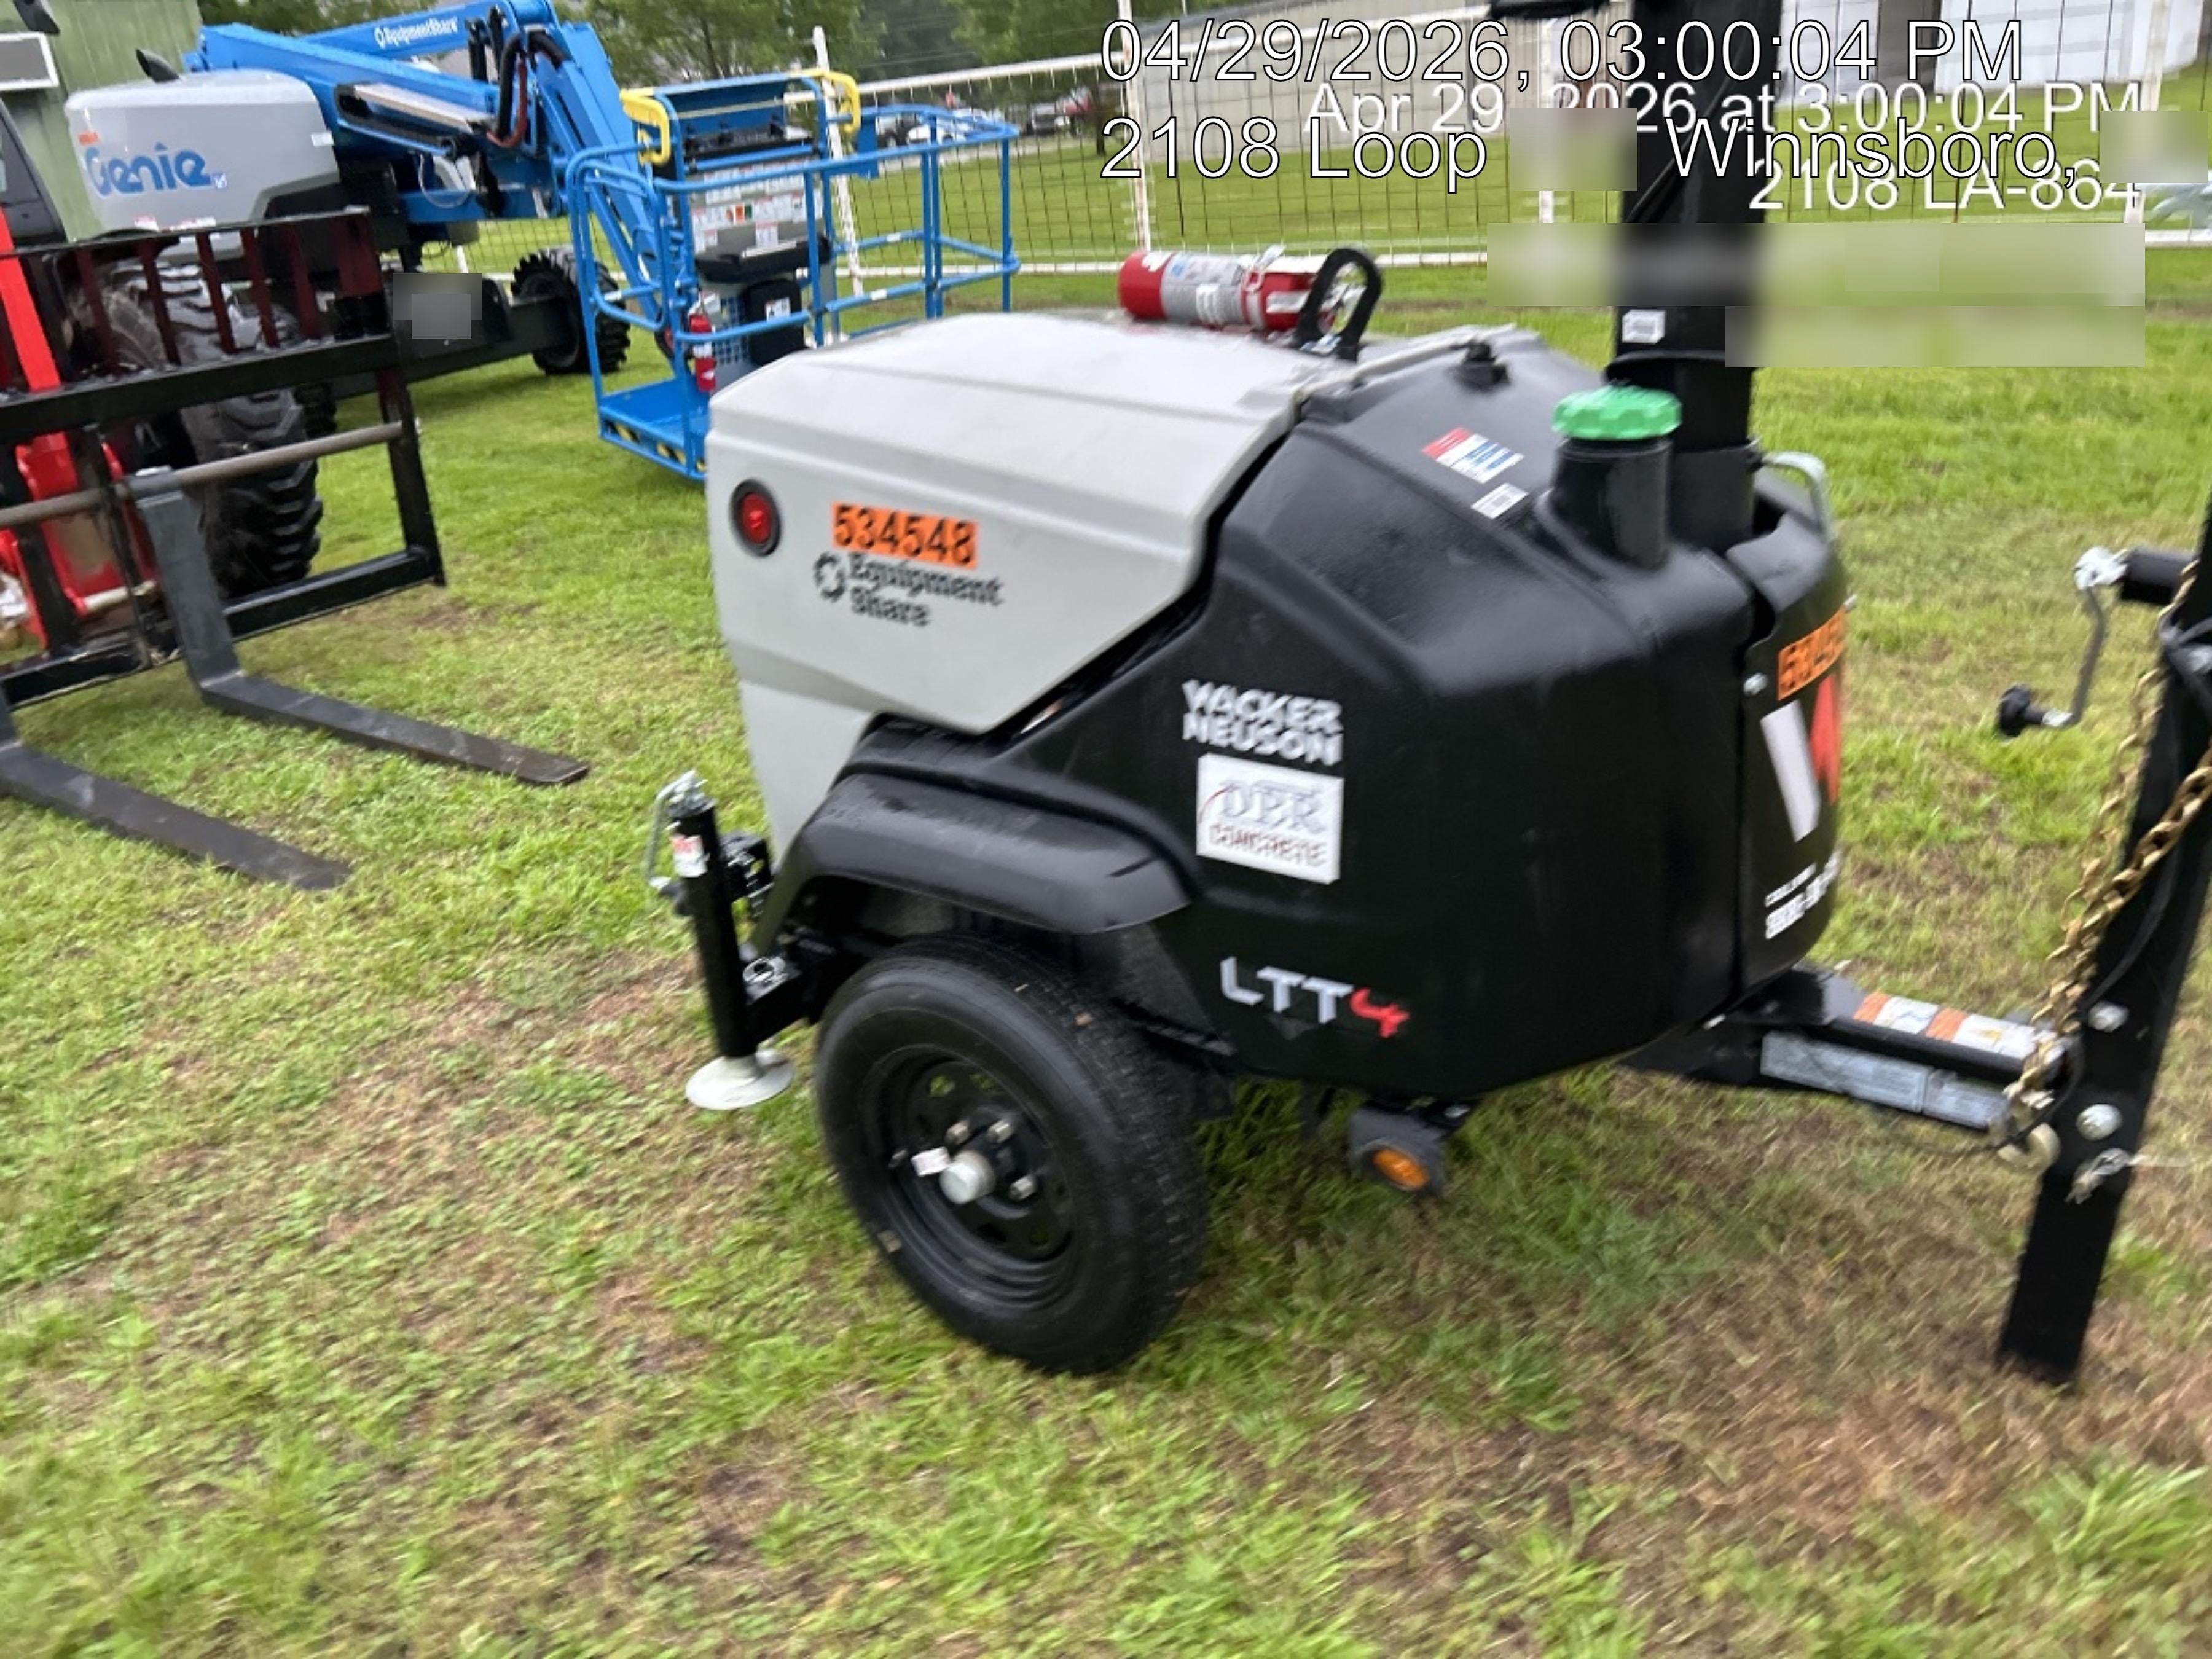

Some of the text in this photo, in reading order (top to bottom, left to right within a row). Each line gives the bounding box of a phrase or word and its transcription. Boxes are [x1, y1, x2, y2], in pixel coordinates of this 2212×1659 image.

[85, 141, 211, 197] Genie
[834, 503, 974, 565] 534548
[847, 551, 1005, 607] Equipment
[850, 586, 931, 627] Share
[1182, 678, 1344, 735] WACKER
[1182, 712, 1344, 766] NEUSON
[1220, 955, 1410, 1039] LTT4
